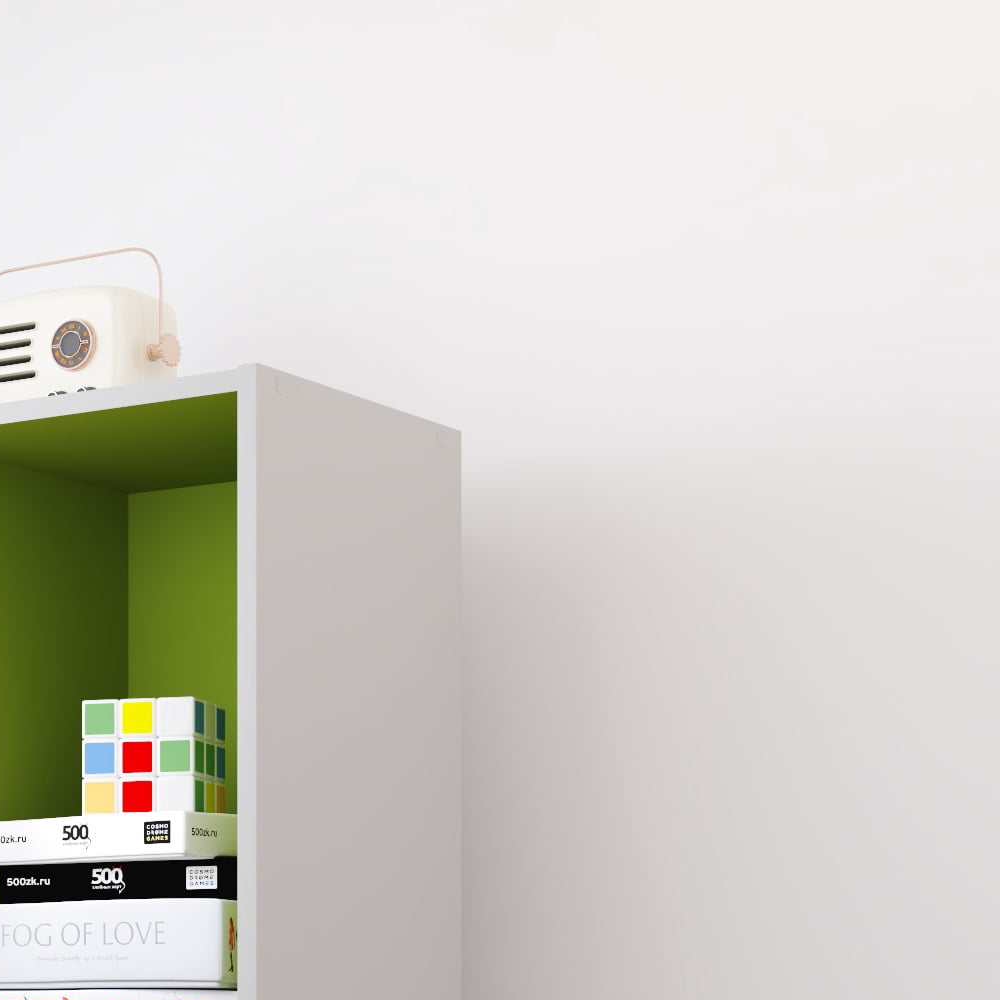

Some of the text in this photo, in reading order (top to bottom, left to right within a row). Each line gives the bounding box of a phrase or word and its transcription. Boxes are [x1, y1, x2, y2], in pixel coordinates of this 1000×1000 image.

[62, 823, 90, 842] 500
[6, 877, 51, 888] 500zk.ru
[91, 868, 123, 886] 500
[1, 920, 167, 947] FOG OF LOVE
